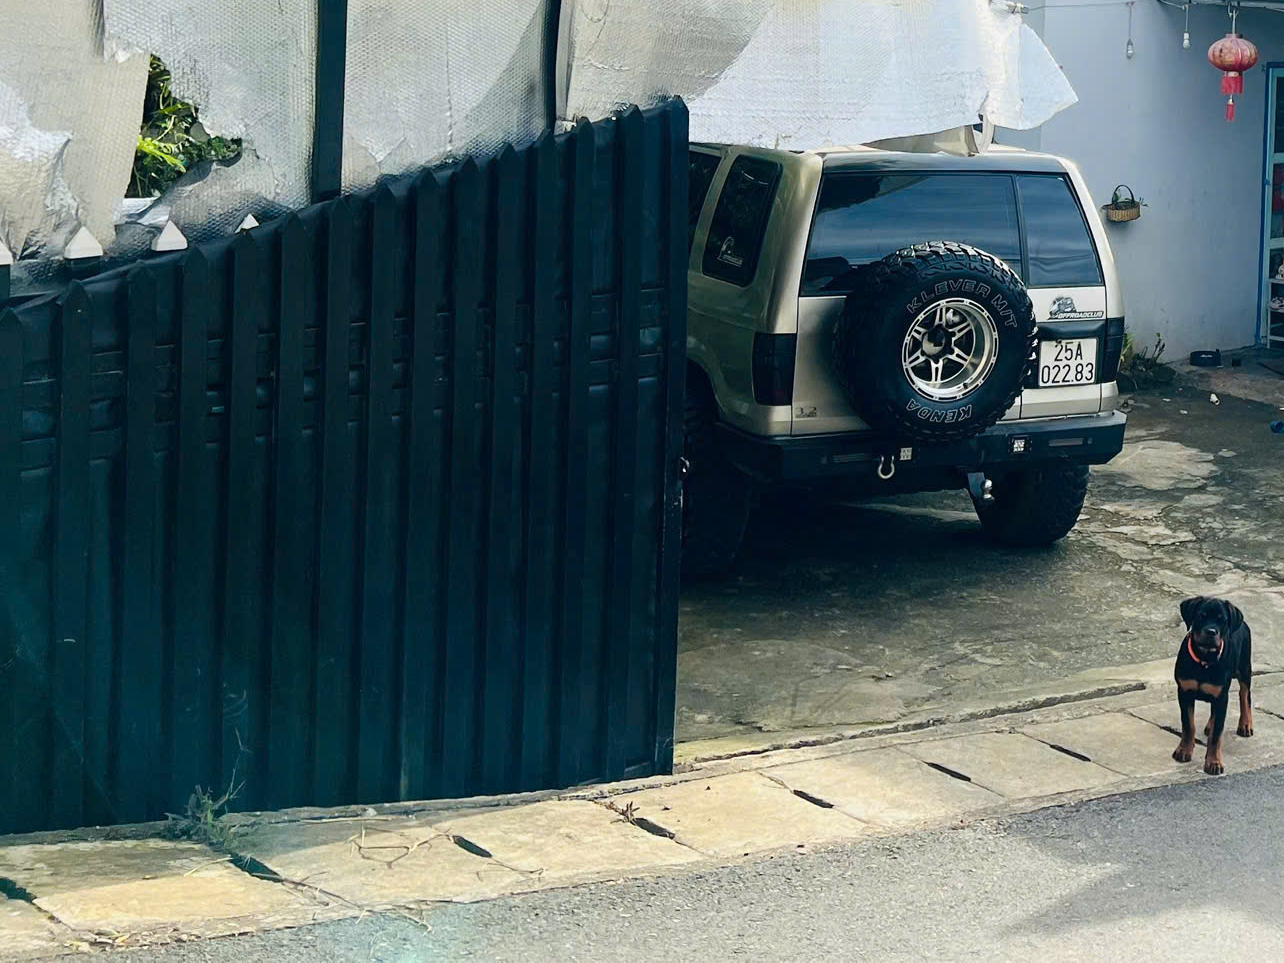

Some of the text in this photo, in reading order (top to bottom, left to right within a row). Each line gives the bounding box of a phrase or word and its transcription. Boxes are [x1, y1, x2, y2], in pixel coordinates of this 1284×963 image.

[907, 279, 991, 314] KLEVER
[1054, 341, 1083, 362] 25A
[1041, 363, 1094, 384] 022.83
[906, 399, 972, 423] KENDA
